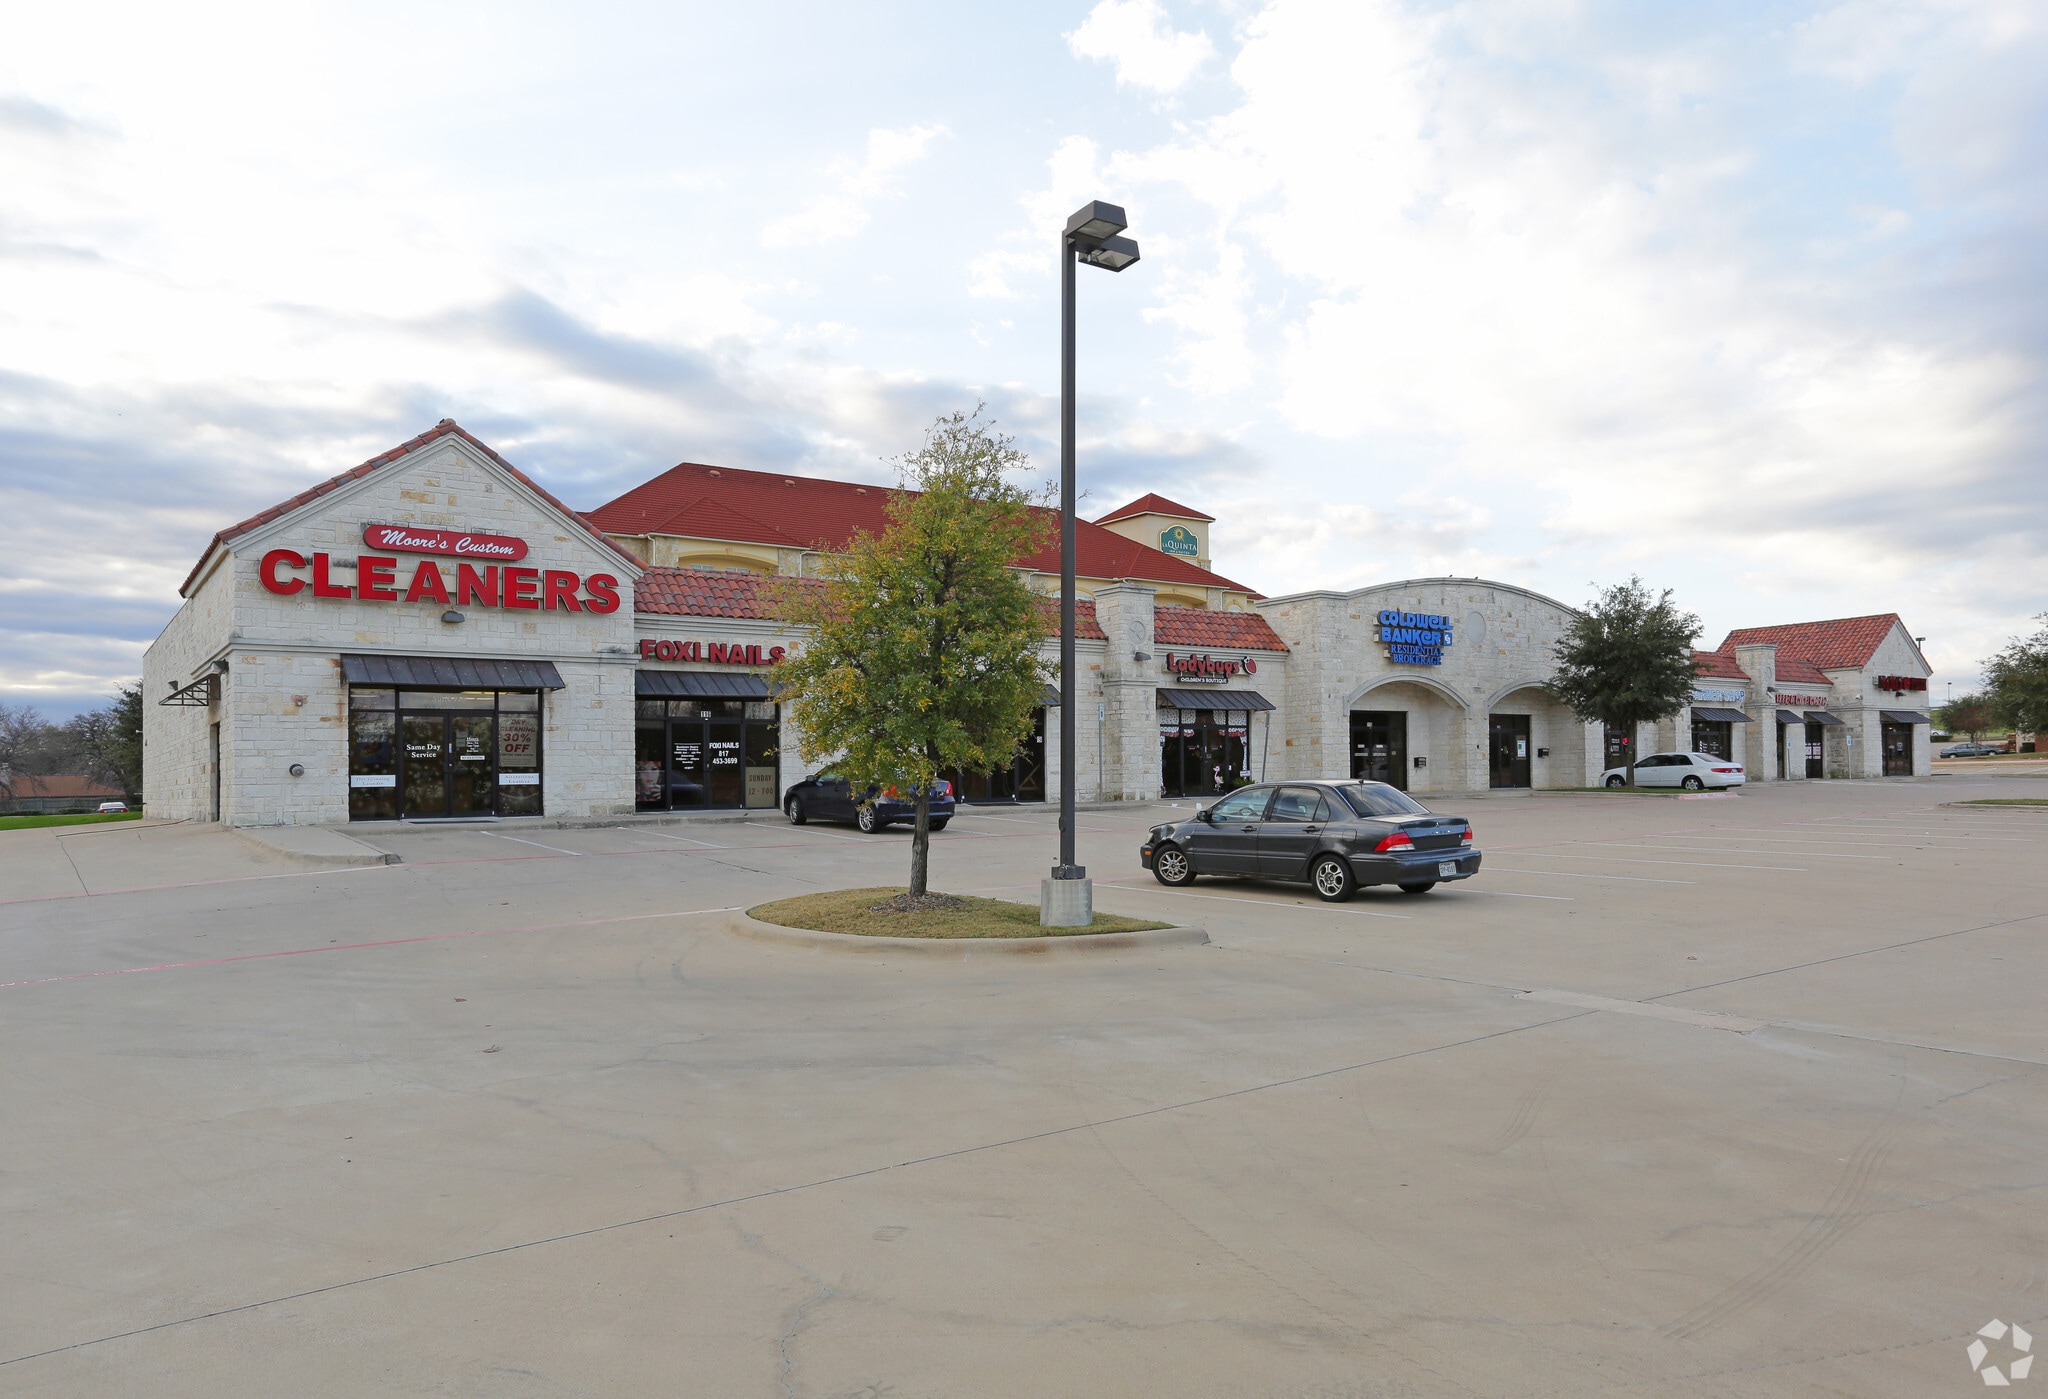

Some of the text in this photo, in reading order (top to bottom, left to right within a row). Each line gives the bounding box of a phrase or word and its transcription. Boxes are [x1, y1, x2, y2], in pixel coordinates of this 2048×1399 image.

[381, 529, 515, 555] Moore's Custom
[1168, 540, 1197, 551] QUINTA
[258, 548, 622, 615] CLEANERS
[639, 638, 786, 666] FOXI NAILS
[1390, 643, 1444, 657] RESIDENTIAL
[1166, 652, 1240, 678] Ladybugs
[1392, 653, 1442, 666] BROKERAGE
[503, 733, 531, 742] 30%
[406, 743, 441, 752] Same Day
[504, 743, 530, 753] OFF
[411, 751, 437, 759] Service
[749, 774, 772, 782] SUNDAY
[748, 787, 756, 795] 12
